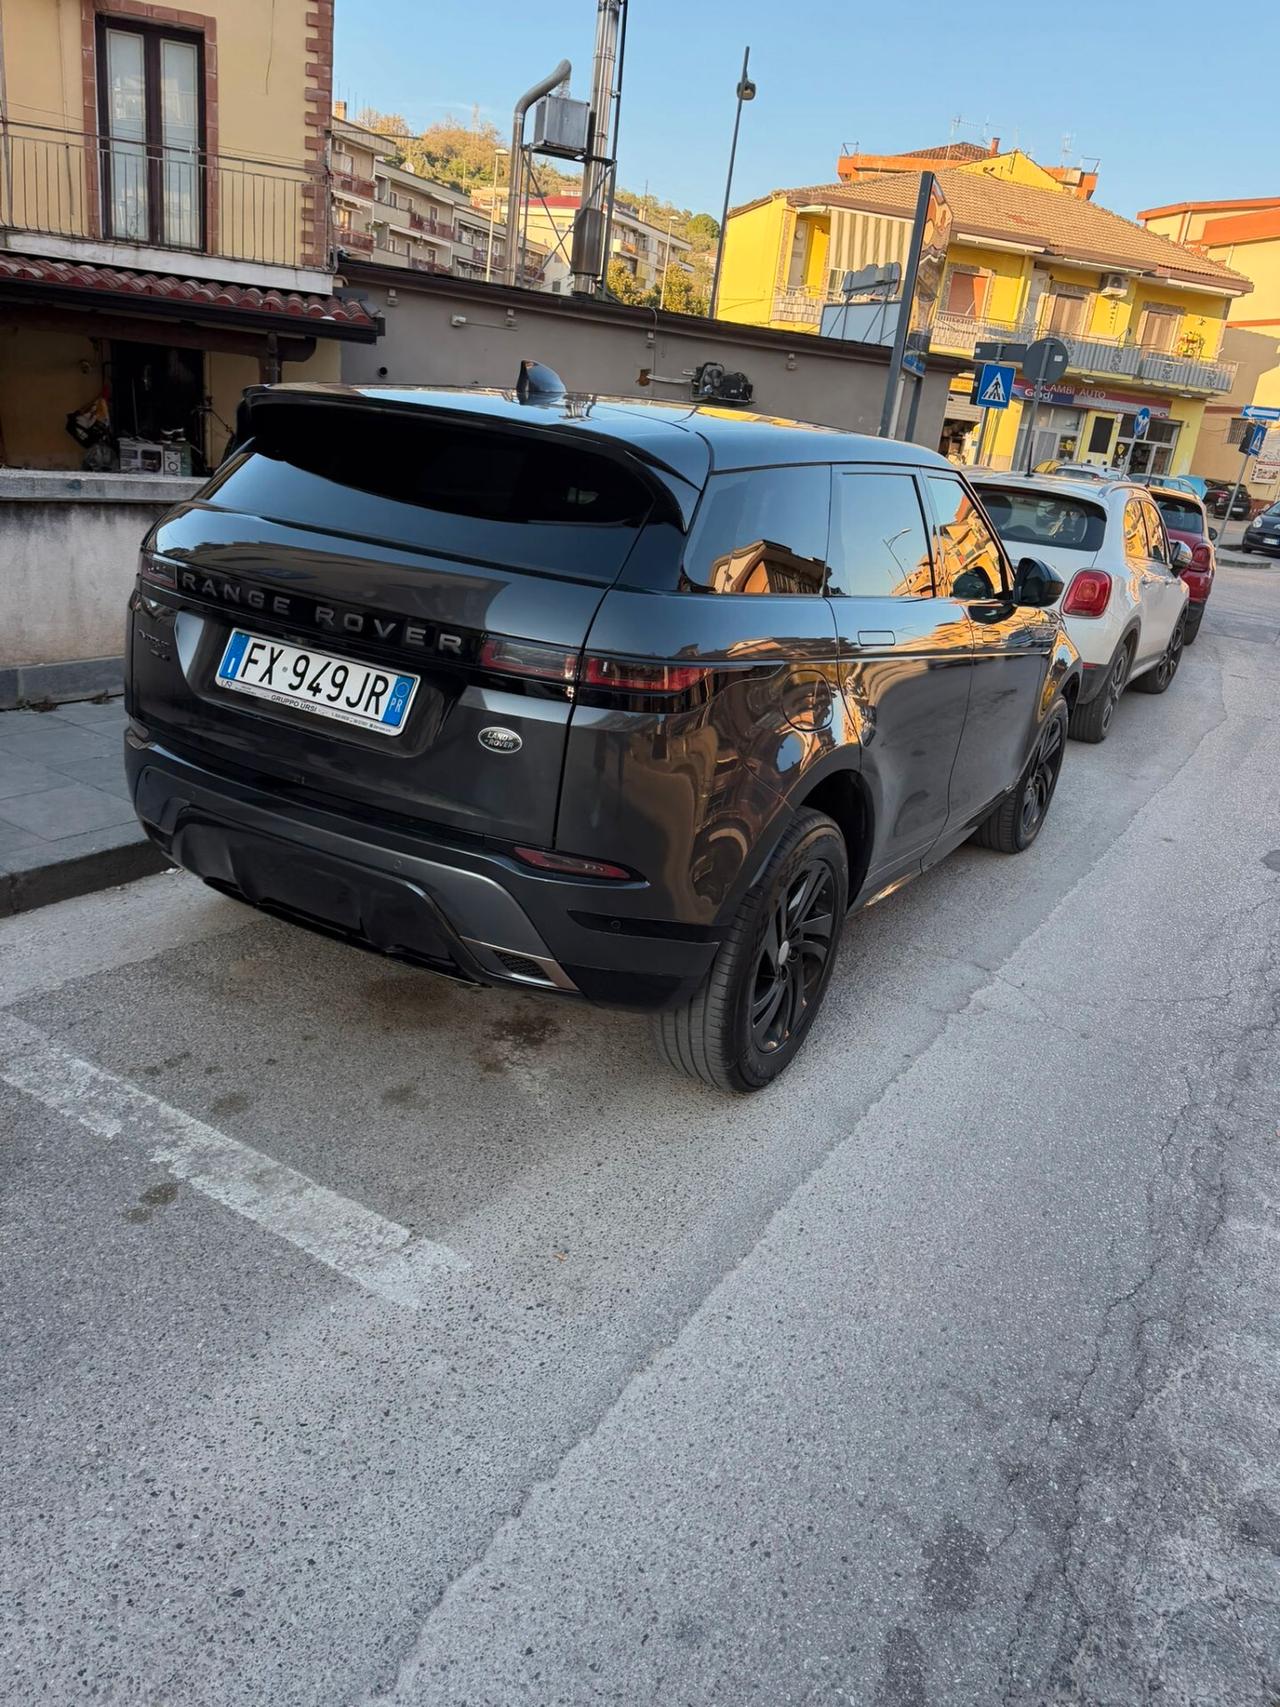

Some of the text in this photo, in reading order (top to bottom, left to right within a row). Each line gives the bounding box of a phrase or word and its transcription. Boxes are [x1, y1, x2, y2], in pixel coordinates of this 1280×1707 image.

[1080, 388, 1106, 400] AUTO
[181, 572, 464, 655] RANGE ROVER
[271, 693, 318, 713] GRUPPO URSI
[390, 697, 404, 714] PR
[487, 731, 509, 741] LAND
[488, 738, 514, 749] ROVER
